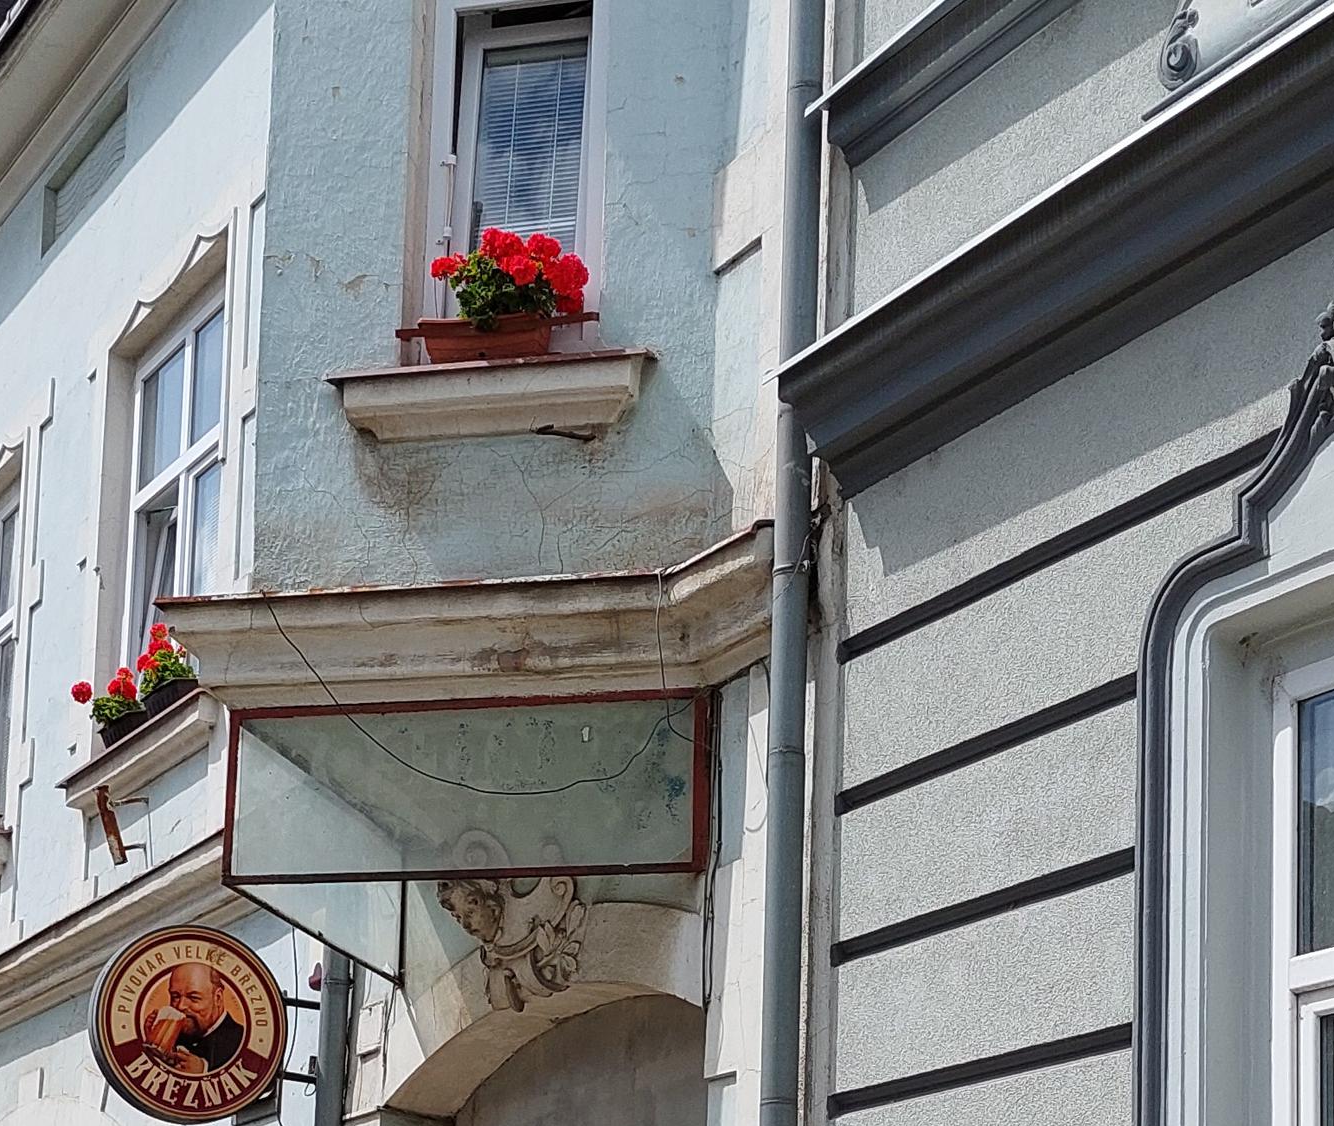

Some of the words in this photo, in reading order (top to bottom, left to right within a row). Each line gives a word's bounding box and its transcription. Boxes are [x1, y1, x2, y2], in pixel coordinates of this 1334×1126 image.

[117, 952, 166, 1014] PIVOVAR
[173, 945, 227, 966] VELKÉ
[230, 964, 268, 1027] BŘEZNO
[124, 1051, 258, 1109] BŘEZŇÁK
